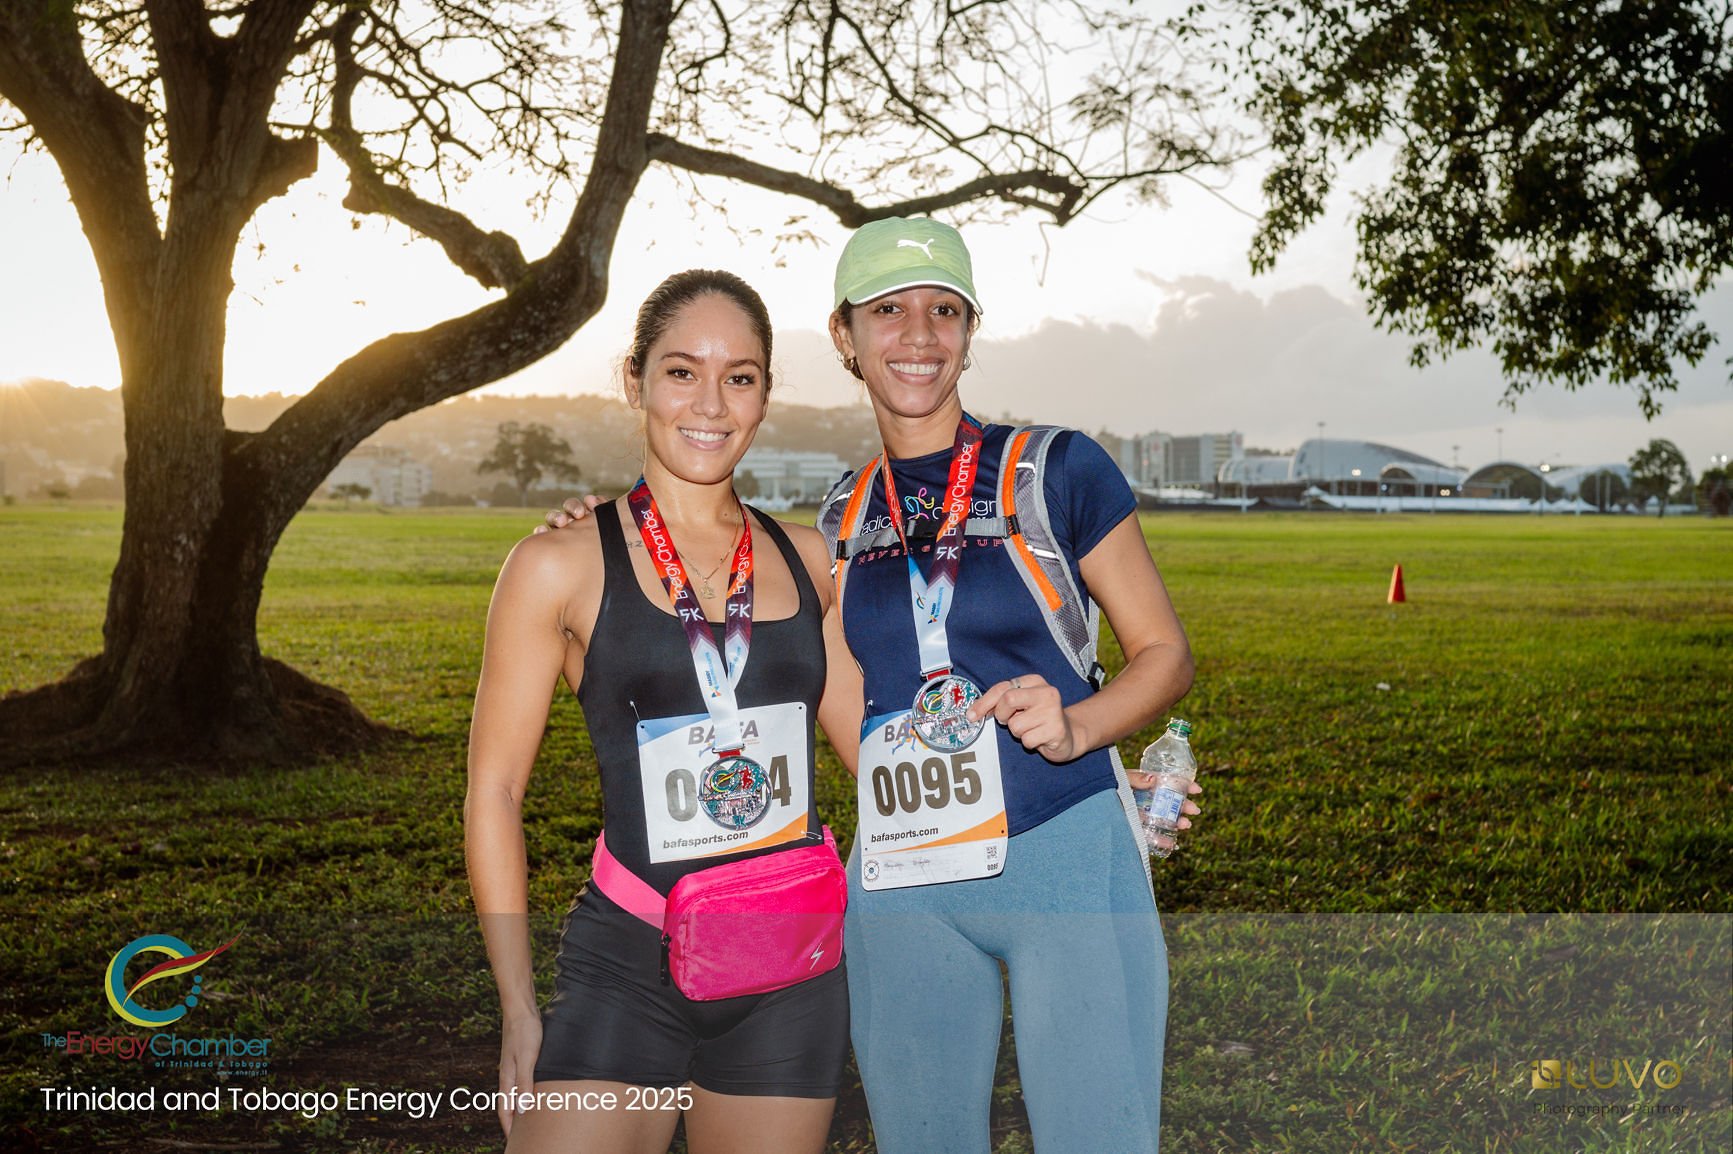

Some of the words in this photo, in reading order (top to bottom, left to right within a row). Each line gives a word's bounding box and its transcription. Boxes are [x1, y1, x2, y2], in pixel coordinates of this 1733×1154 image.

[943, 441, 974, 536] EnergyChamber
[641, 509, 688, 600] EnergyChamber
[936, 546, 959, 560] 5K
[680, 607, 704, 622] 5K
[728, 603, 750, 618] 5K
[688, 719, 759, 745] BAA
[872, 751, 982, 817] 0095
[663, 830, 749, 849] bafasports.com
[871, 827, 939, 843] bafasports.com
